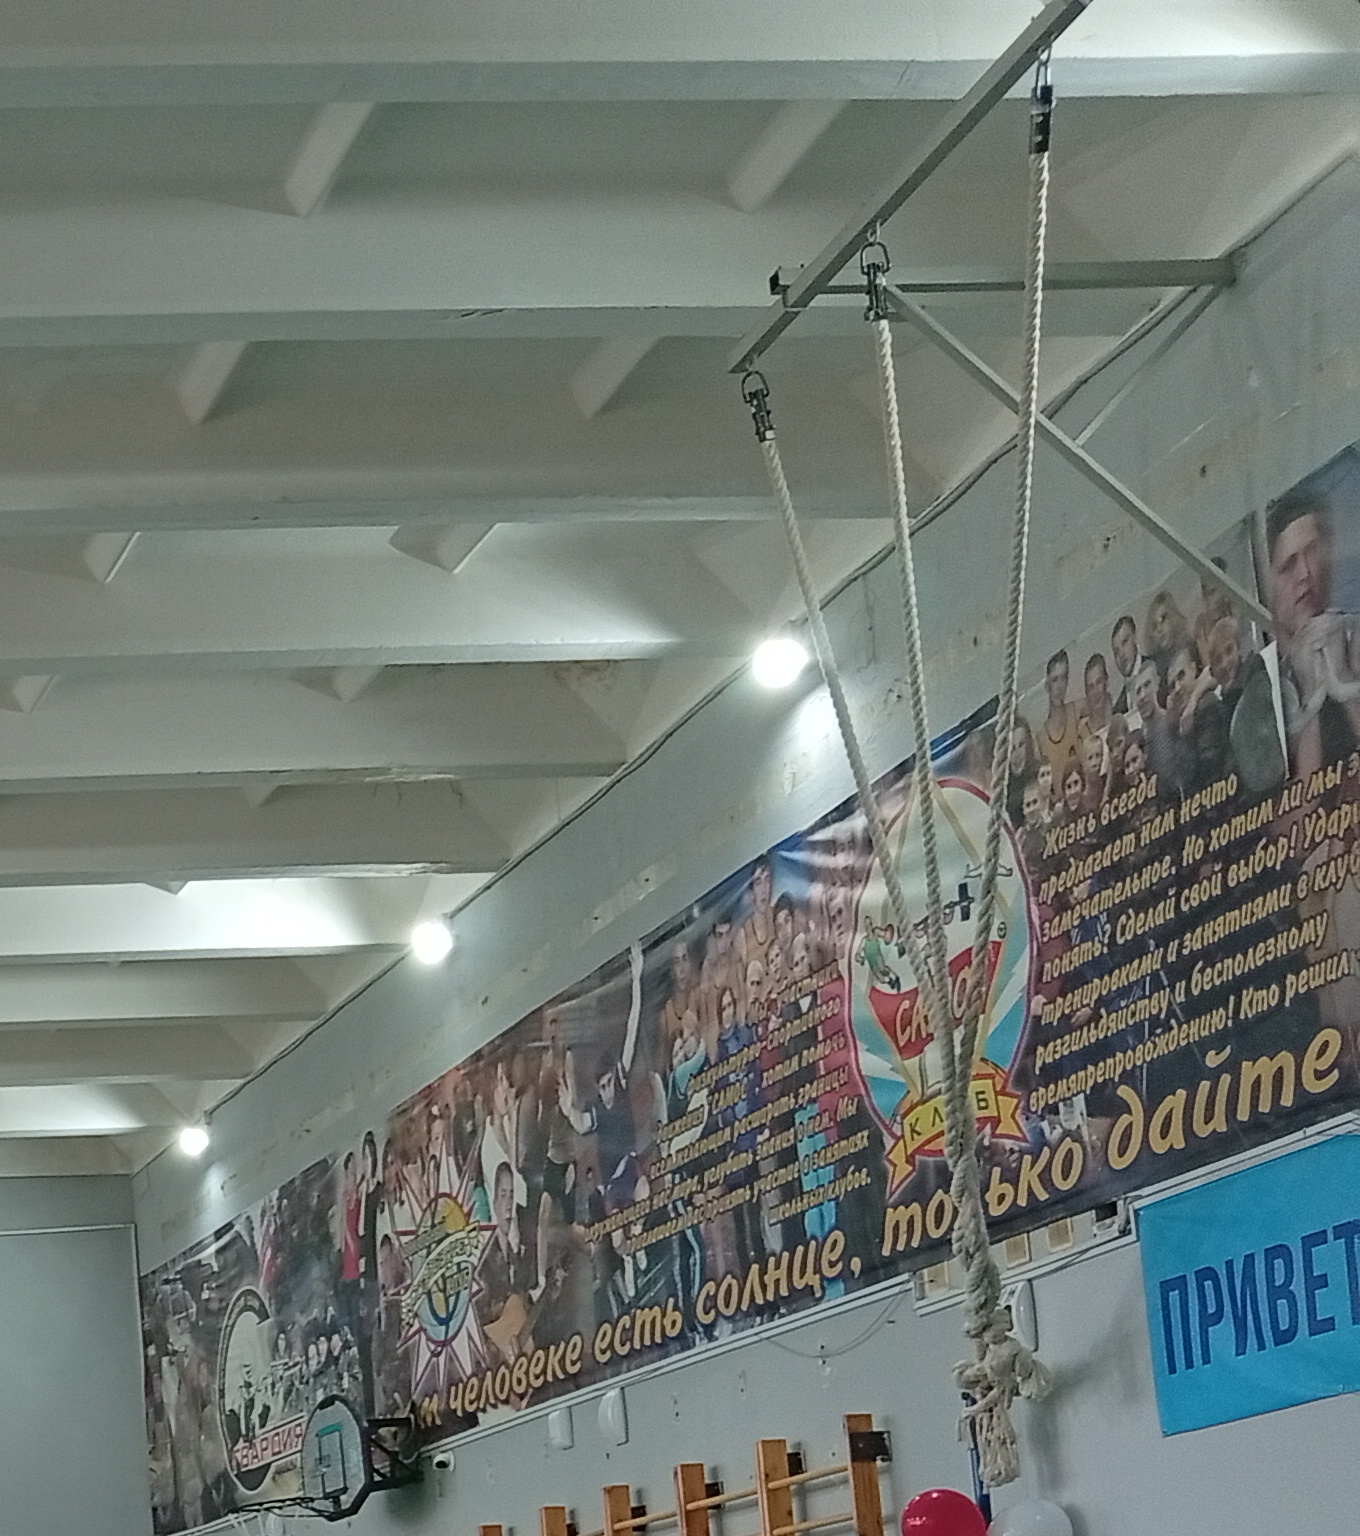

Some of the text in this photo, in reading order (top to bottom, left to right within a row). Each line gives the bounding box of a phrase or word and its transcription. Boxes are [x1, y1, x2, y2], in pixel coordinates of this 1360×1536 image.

[1039, 773, 1238, 904] предлагает нам нечто
[1041, 856, 1176, 943] замечательное.
[1182, 835, 1204, 866] Но
[1209, 798, 1273, 852] хотим
[1279, 782, 1302, 816] ли
[1306, 760, 1343, 801] мы
[1042, 772, 1158, 859] Жизнь всегда
[1041, 947, 1164, 1026] тренировками
[1167, 938, 1180, 963] и
[1182, 881, 1292, 955] занятиями
[1296, 873, 1309, 899] в
[1042, 923, 1112, 983] понять?
[1115, 886, 1176, 944] Сделай
[1180, 861, 1223, 912] свой
[1228, 824, 1297, 888] выбор!
[1175, 979, 1186, 1004] и
[1190, 911, 1328, 995] бесполезному
[1240, 983, 1279, 1020] Кто
[909, 1090, 989, 1141] КЛБ
[449, 1028, 1343, 1419] человеке есть солнце, тоько дайте
[1159, 1218, 1360, 1376] ПРИВЕТ
